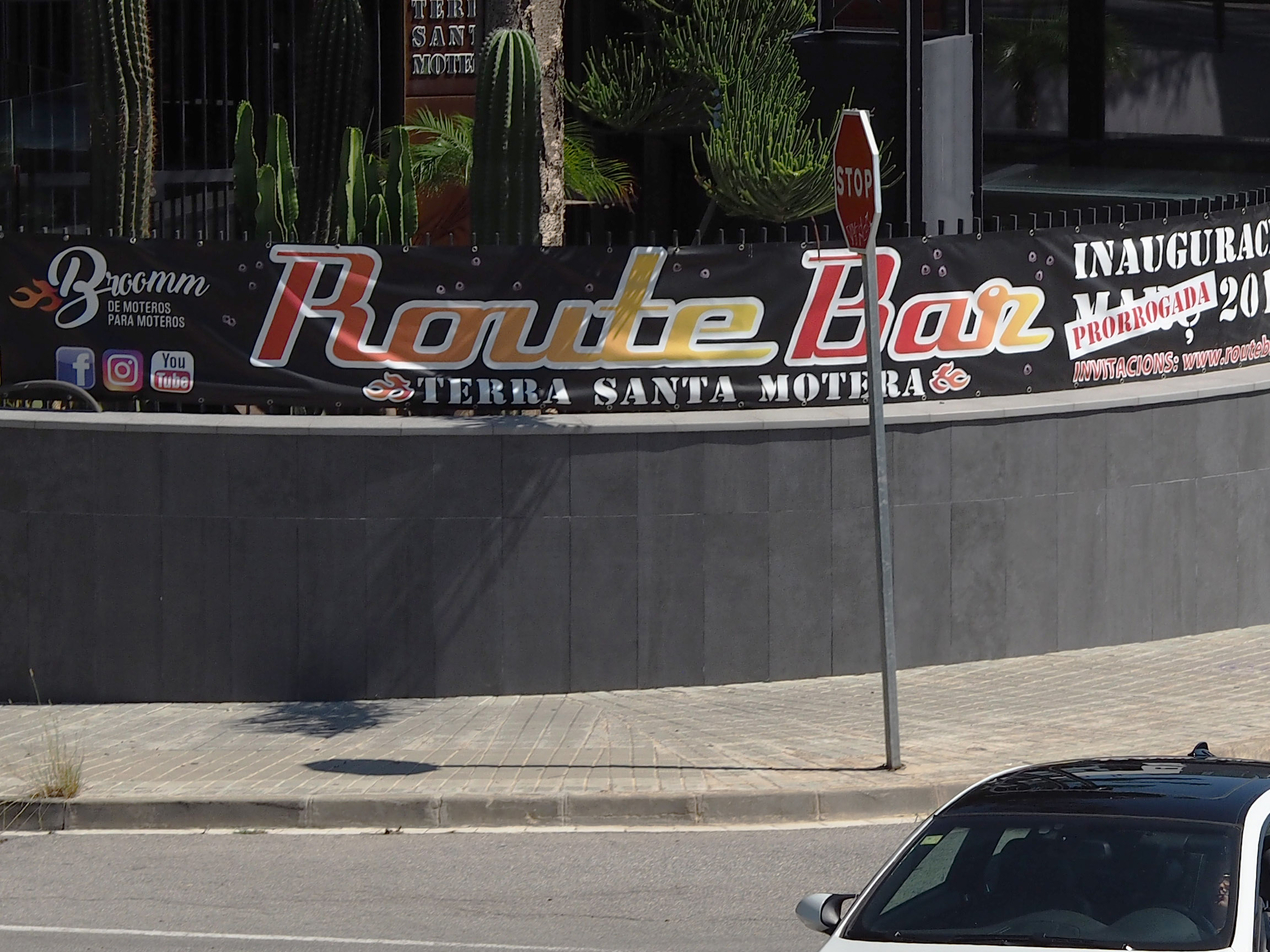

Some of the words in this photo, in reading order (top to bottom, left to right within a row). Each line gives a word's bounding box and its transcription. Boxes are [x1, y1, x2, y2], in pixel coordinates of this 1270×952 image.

[836, 166, 873, 199] STOP
[47, 245, 211, 329] Broomm
[108, 300, 120, 313] DE
[123, 301, 171, 314] MOTEROS
[108, 314, 134, 327] PARA
[137, 316, 185, 328] MOTEROS
[250, 244, 779, 370] Route
[784, 246, 1055, 367] Bar
[1072, 281, 1211, 350] PRORROGADA
[162, 352, 186, 369] You
[1072, 351, 1180, 383] INVITACIONS:
[156, 372, 188, 389] Tube
[417, 377, 571, 405] TERRA
[593, 375, 737, 405] SANTA
[758, 368, 926, 403] MOTERA
